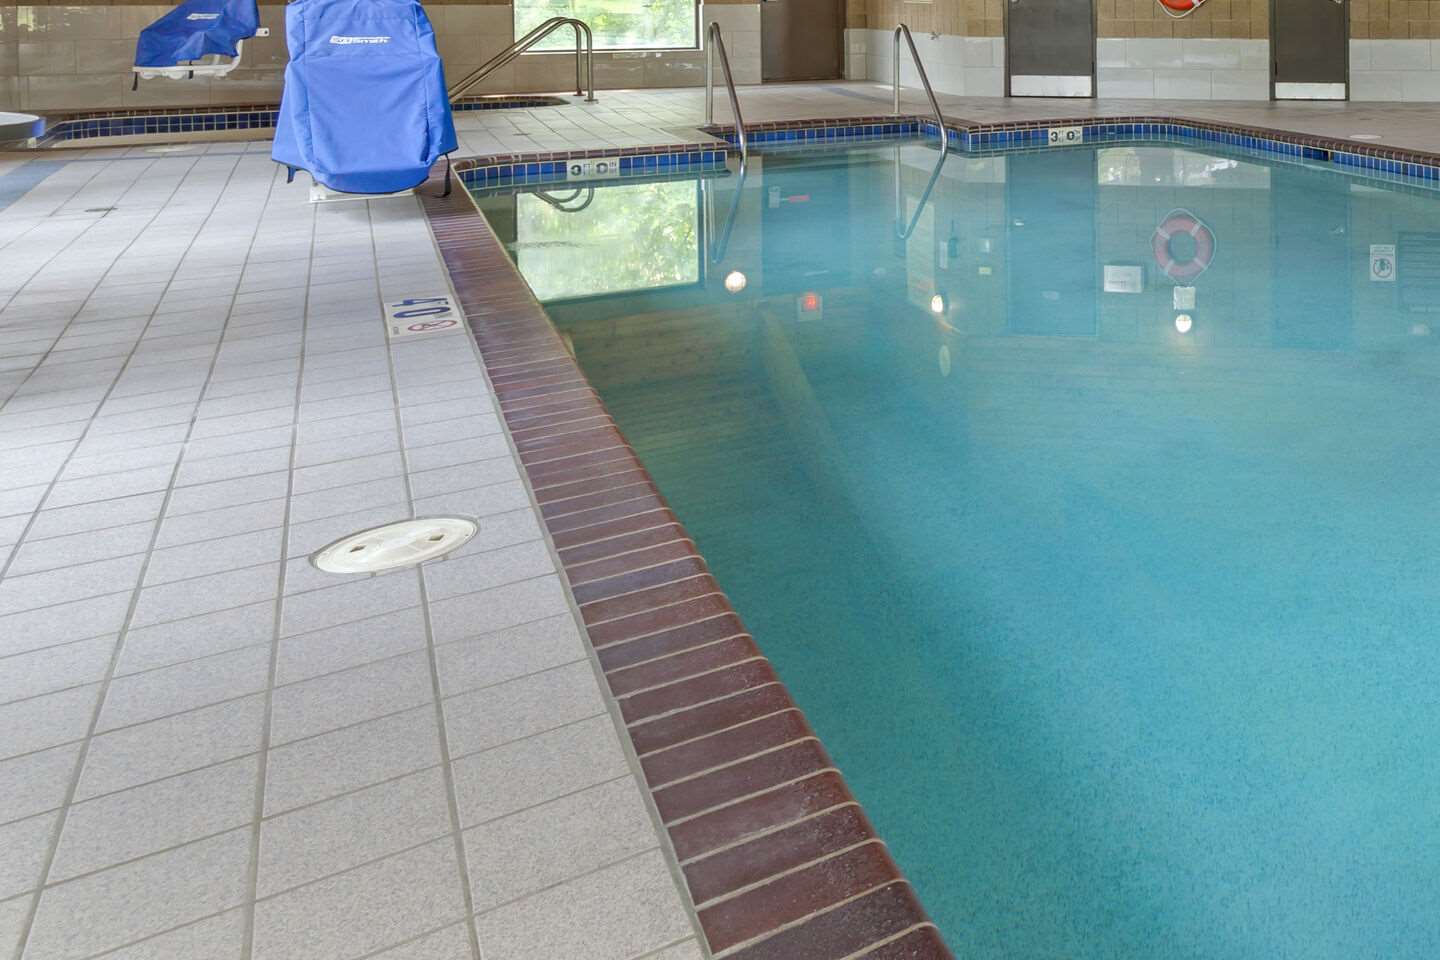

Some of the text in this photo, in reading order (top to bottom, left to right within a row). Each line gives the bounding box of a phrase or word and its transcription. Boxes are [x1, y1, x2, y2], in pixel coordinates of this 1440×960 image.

[1050, 131, 1058, 142] 3
[571, 164, 581, 176] 3
[392, 298, 451, 318] 4 0
